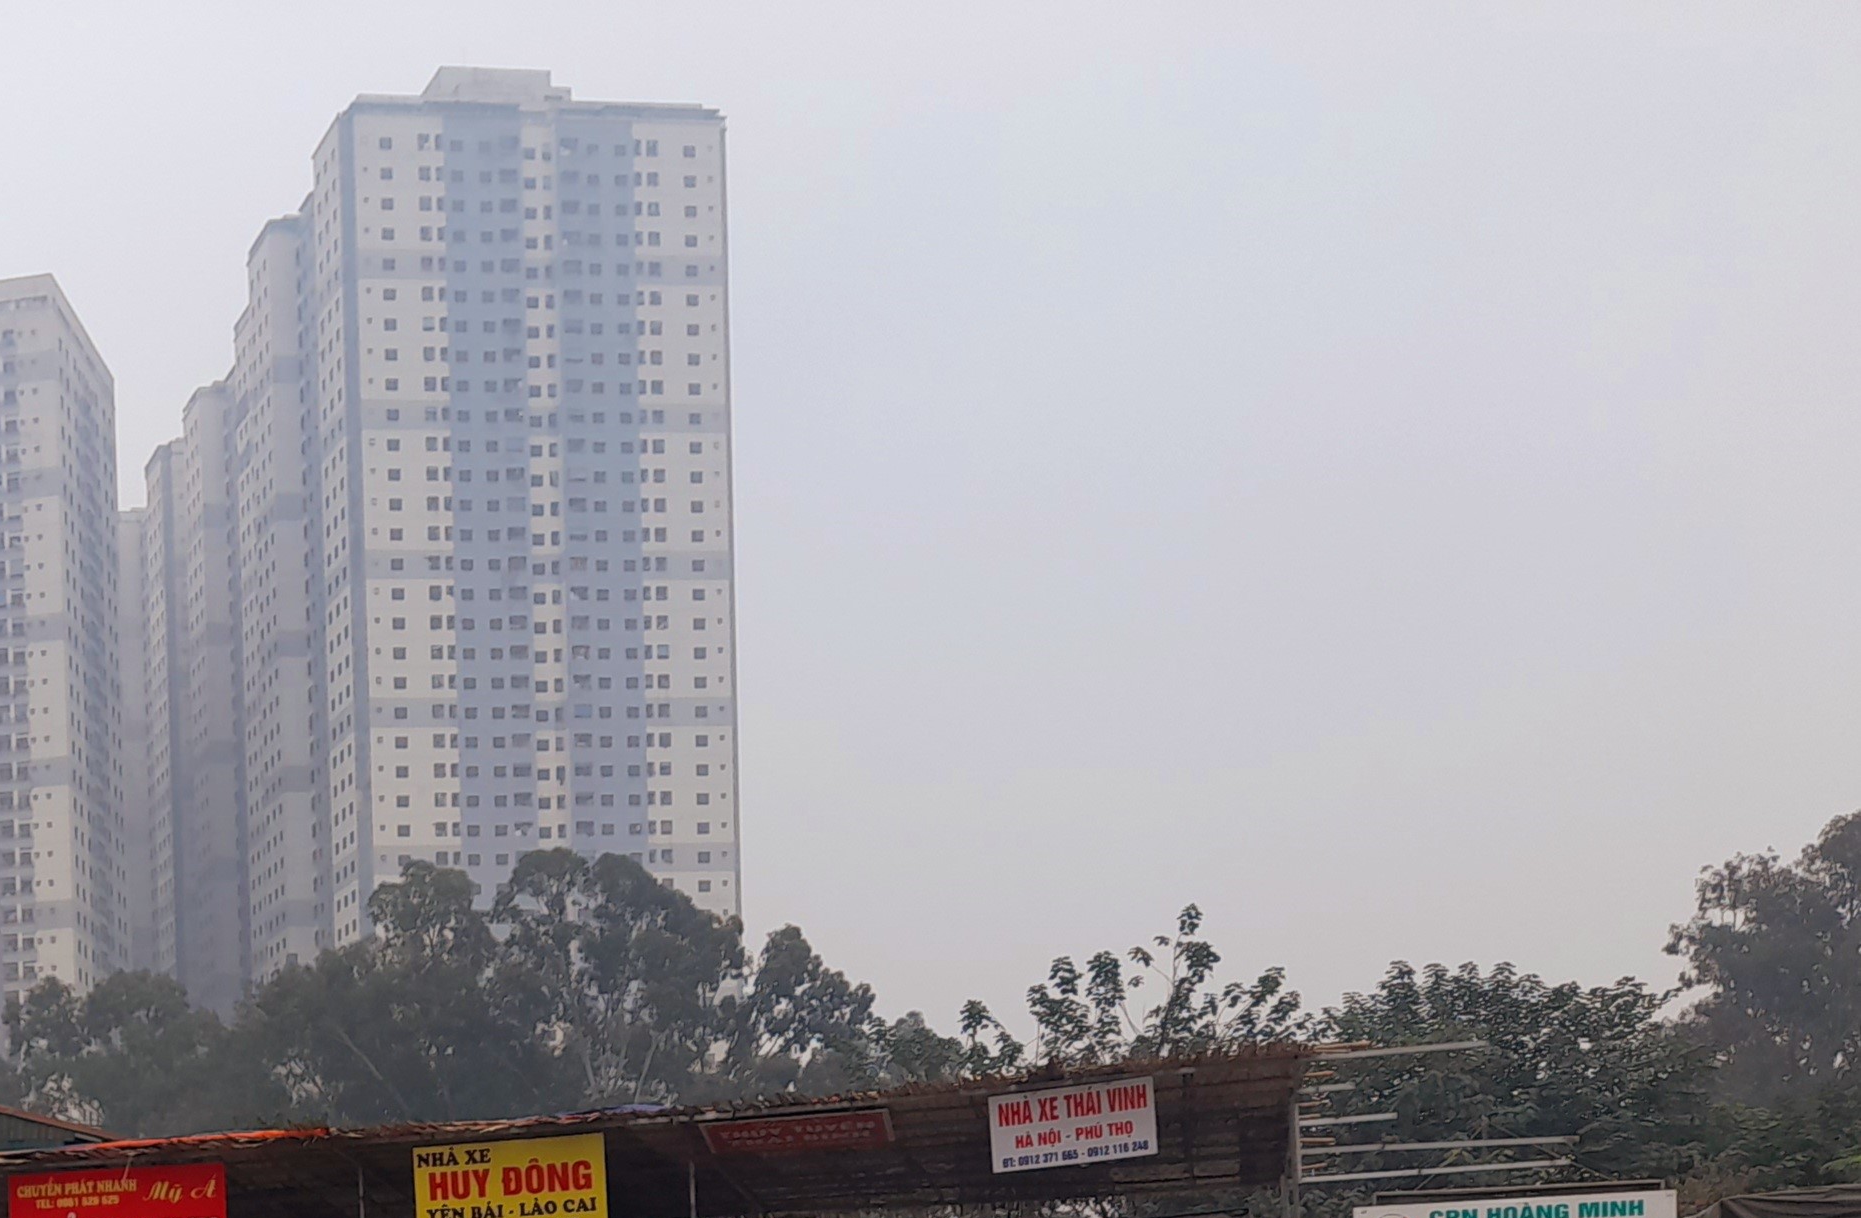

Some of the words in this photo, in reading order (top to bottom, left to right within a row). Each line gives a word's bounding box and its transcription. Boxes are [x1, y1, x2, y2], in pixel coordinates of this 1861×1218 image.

[998, 1095, 1033, 1127] NHÀ
[1038, 1096, 1059, 1122] XE
[1063, 1086, 1102, 1119] THÁI
[1106, 1083, 1148, 1113] VINH
[1015, 1130, 1034, 1149] HÀ
[1038, 1128, 1061, 1147] NỘI
[1075, 1122, 1103, 1141] PHÚ
[1106, 1120, 1134, 1138] THỌ
[416, 1148, 459, 1168] NHÀ
[465, 1148, 491, 1164] XE
[17, 1176, 62, 1198] CHUYỂN
[65, 1178, 95, 1196] PHÁT
[96, 1178, 137, 1193] NHANH
[142, 1180, 185, 1204] Mỹ
[428, 1168, 491, 1201] HUY
[501, 1157, 593, 1196] ĐÔNG
[520, 1197, 557, 1217] LÀO
[563, 1197, 597, 1213] CAI
[1578, 1199, 1645, 1218] MINH
